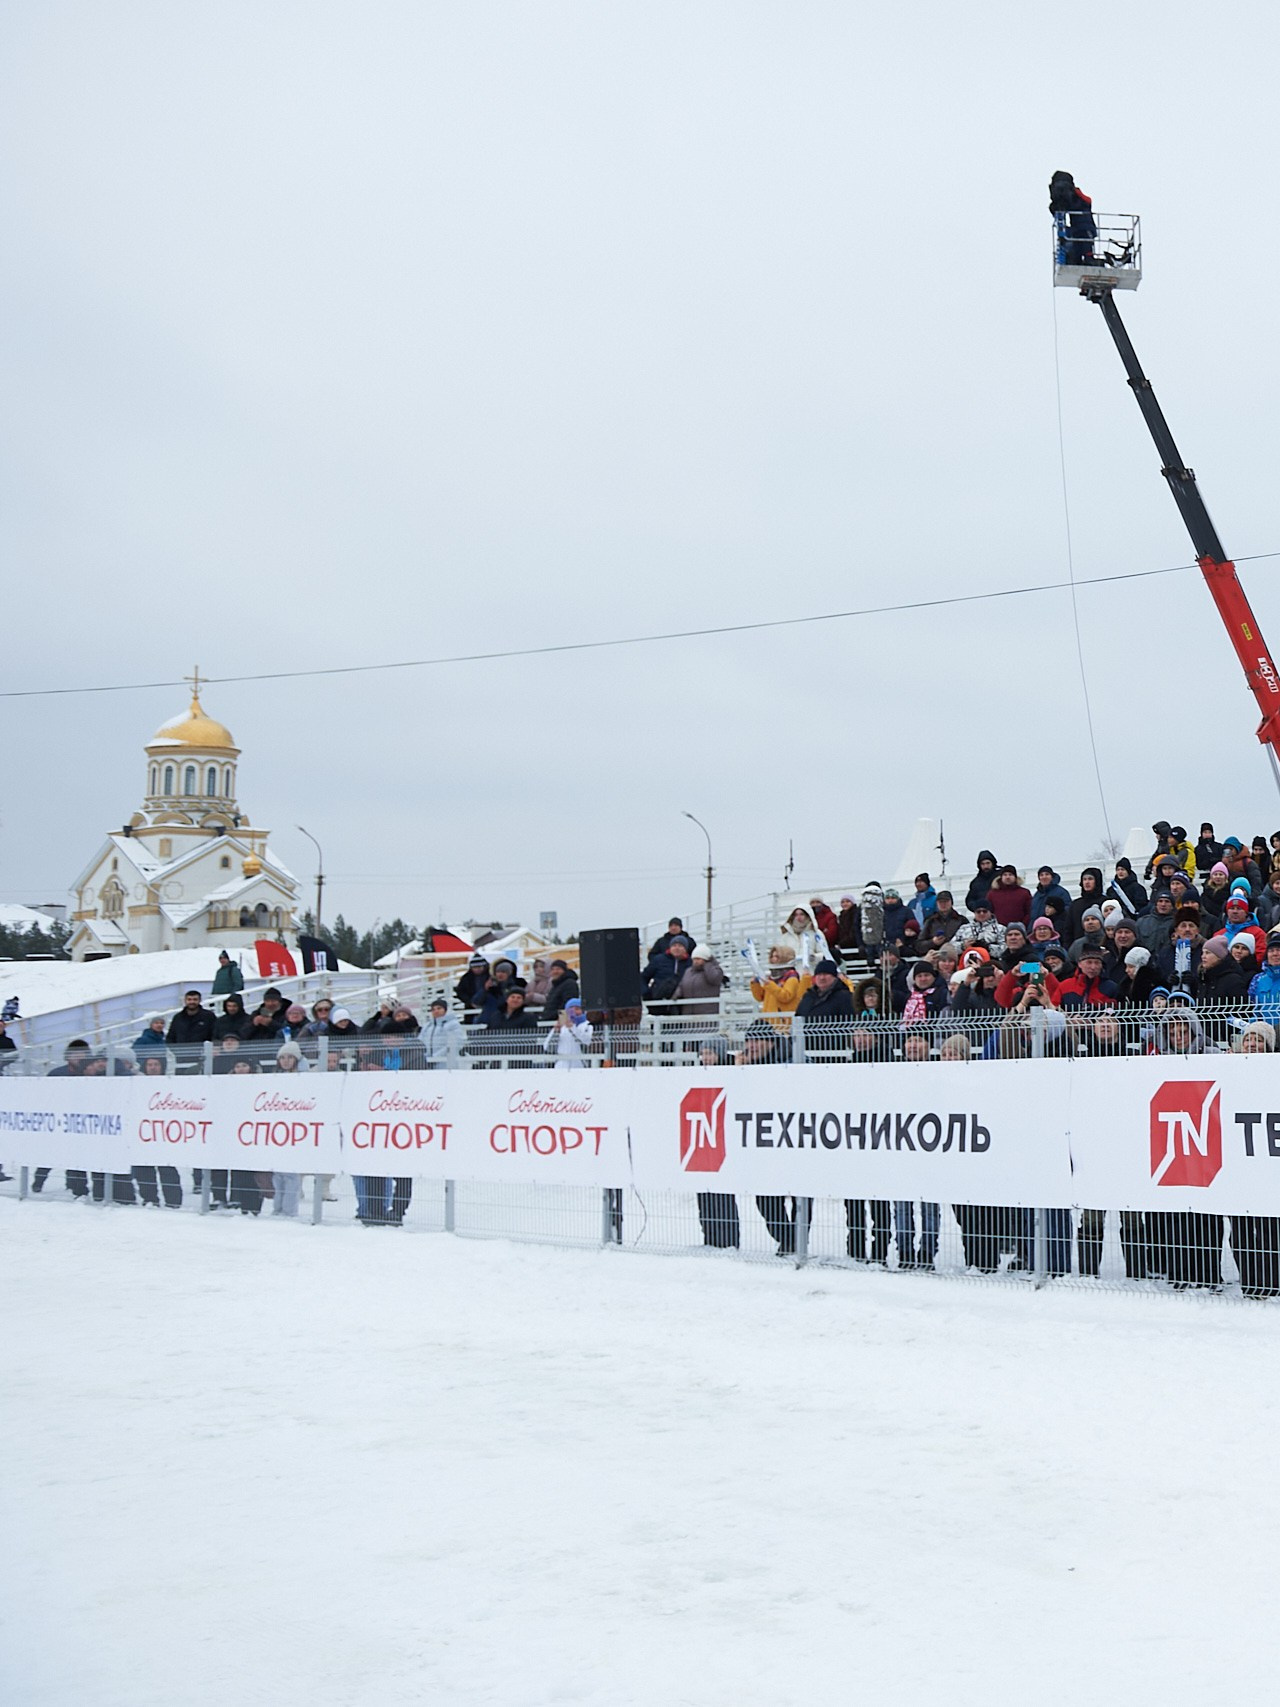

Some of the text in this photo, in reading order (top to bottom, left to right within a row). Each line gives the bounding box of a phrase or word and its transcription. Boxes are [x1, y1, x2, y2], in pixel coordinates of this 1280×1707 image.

[368, 1089, 445, 1112] Советский
[508, 1089, 593, 1113] Советский
[139, 1119, 213, 1144] СПОРТ
[237, 1120, 324, 1147] СПОРТ
[352, 1122, 452, 1150] СПОРТ
[489, 1124, 608, 1156] СПОРТ
[735, 1112, 991, 1153] ТЕХНОНИКОЛЬ
